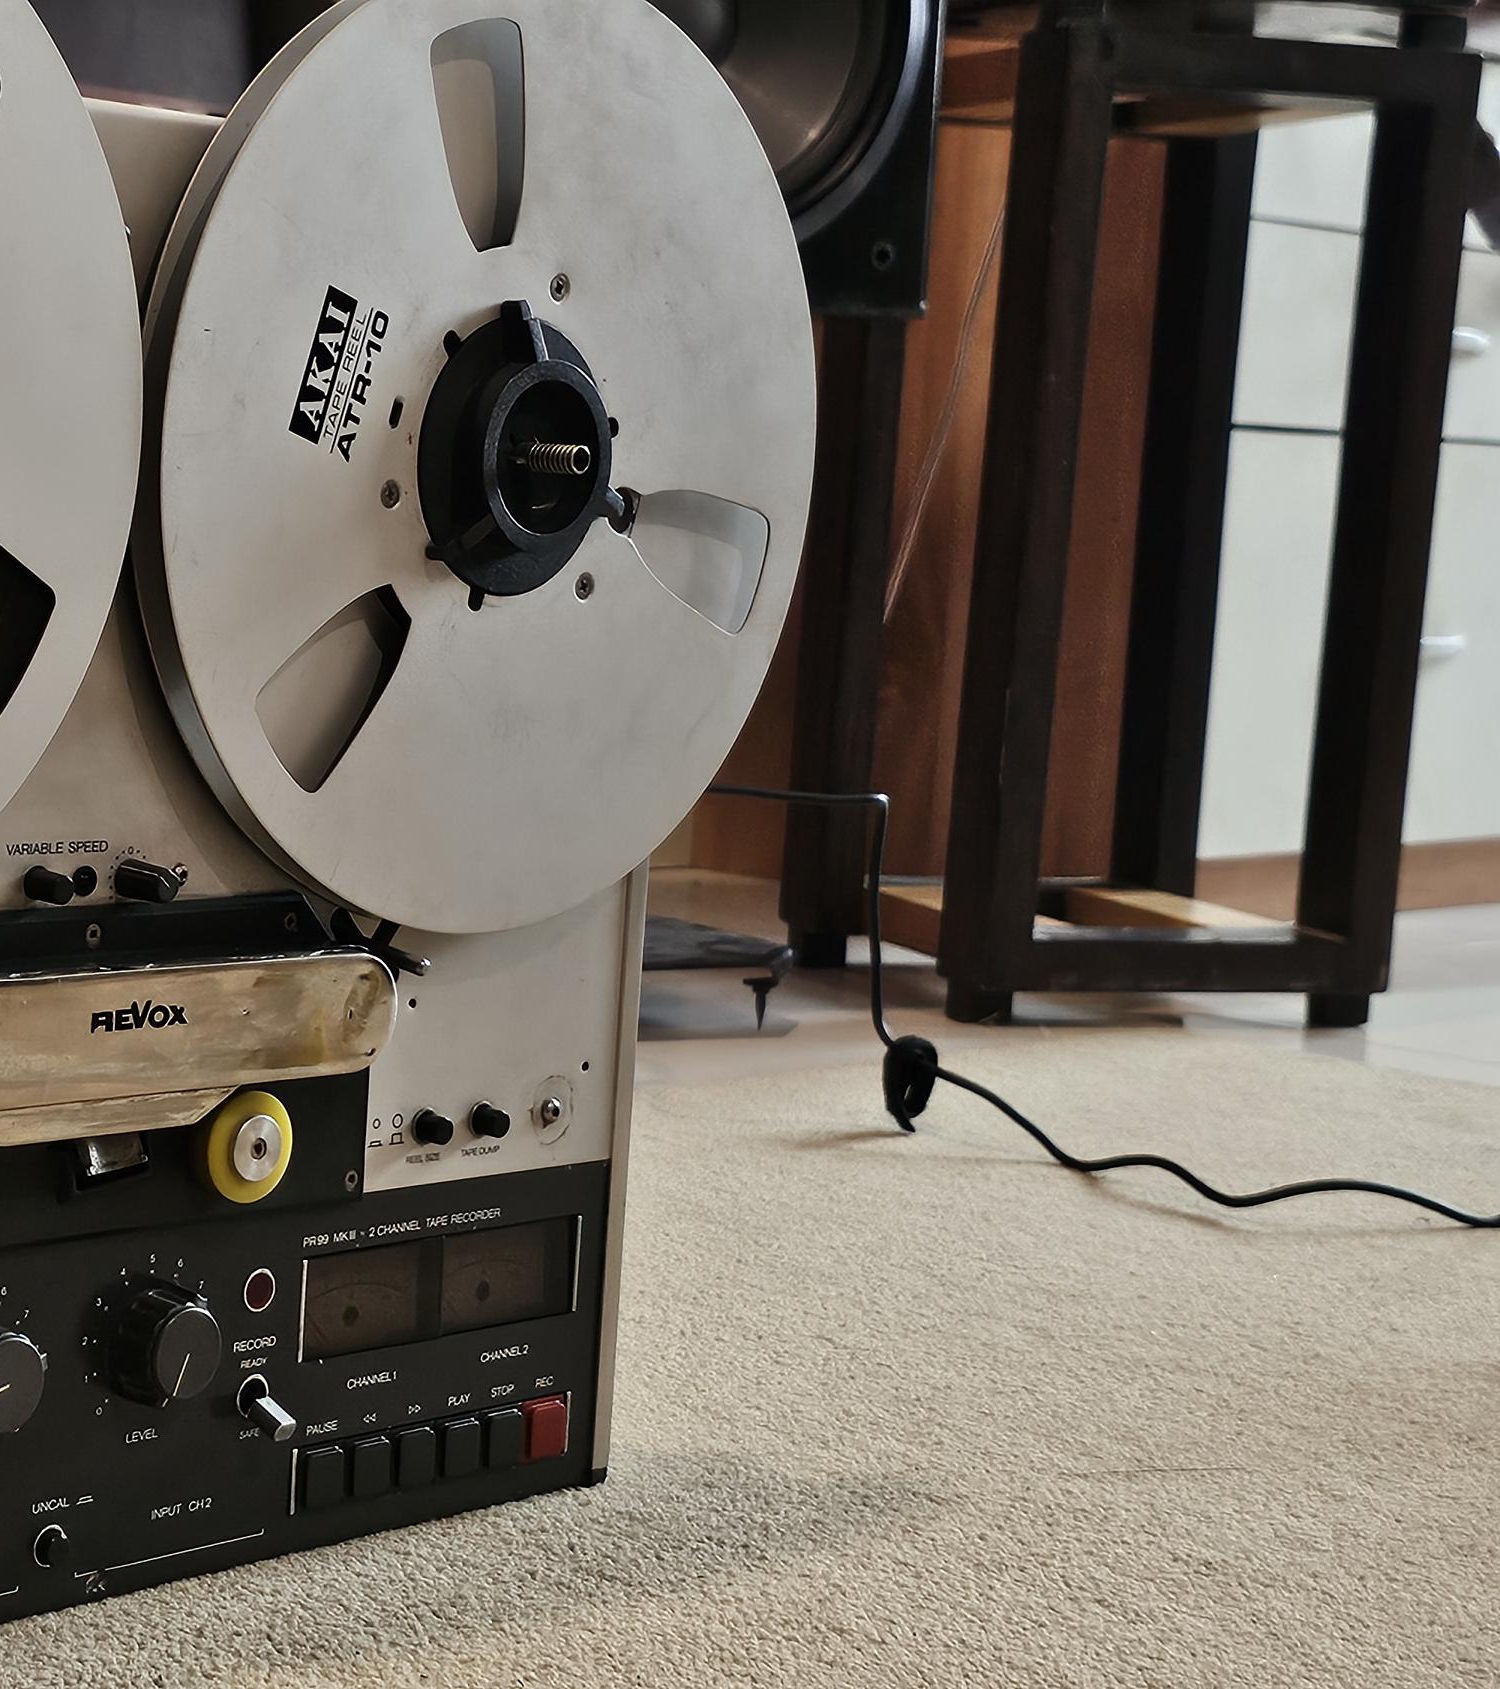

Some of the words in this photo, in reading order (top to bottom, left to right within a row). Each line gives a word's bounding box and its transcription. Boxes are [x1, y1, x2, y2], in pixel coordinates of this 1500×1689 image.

[298, 299, 352, 433] AKAI
[323, 379, 348, 438] TAPE
[342, 314, 367, 372] REEL
[336, 309, 390, 463] ATR-10
[6, 841, 64, 856] VARIABLE
[68, 840, 109, 854] SPEED
[303, 1235, 329, 1248] PR99
[376, 1219, 421, 1237] CHANNEL
[426, 1214, 448, 1228] TAPE
[450, 1207, 501, 1225] RECORDER
[0, 1286, 8, 1296] 6
[233, 1335, 277, 1353] RECORD
[240, 1356, 268, 1369] READY
[490, 1383, 515, 1398] STOP
[534, 1376, 554, 1388] REC
[447, 1392, 472, 1407] PLAY
[125, 1427, 159, 1444] LEVEL
[305, 1419, 339, 1437] PAUSE
[31, 1498, 70, 1515] UNCAL
[150, 1503, 182, 1520] INPUT
[188, 1497, 212, 1512] CH2
